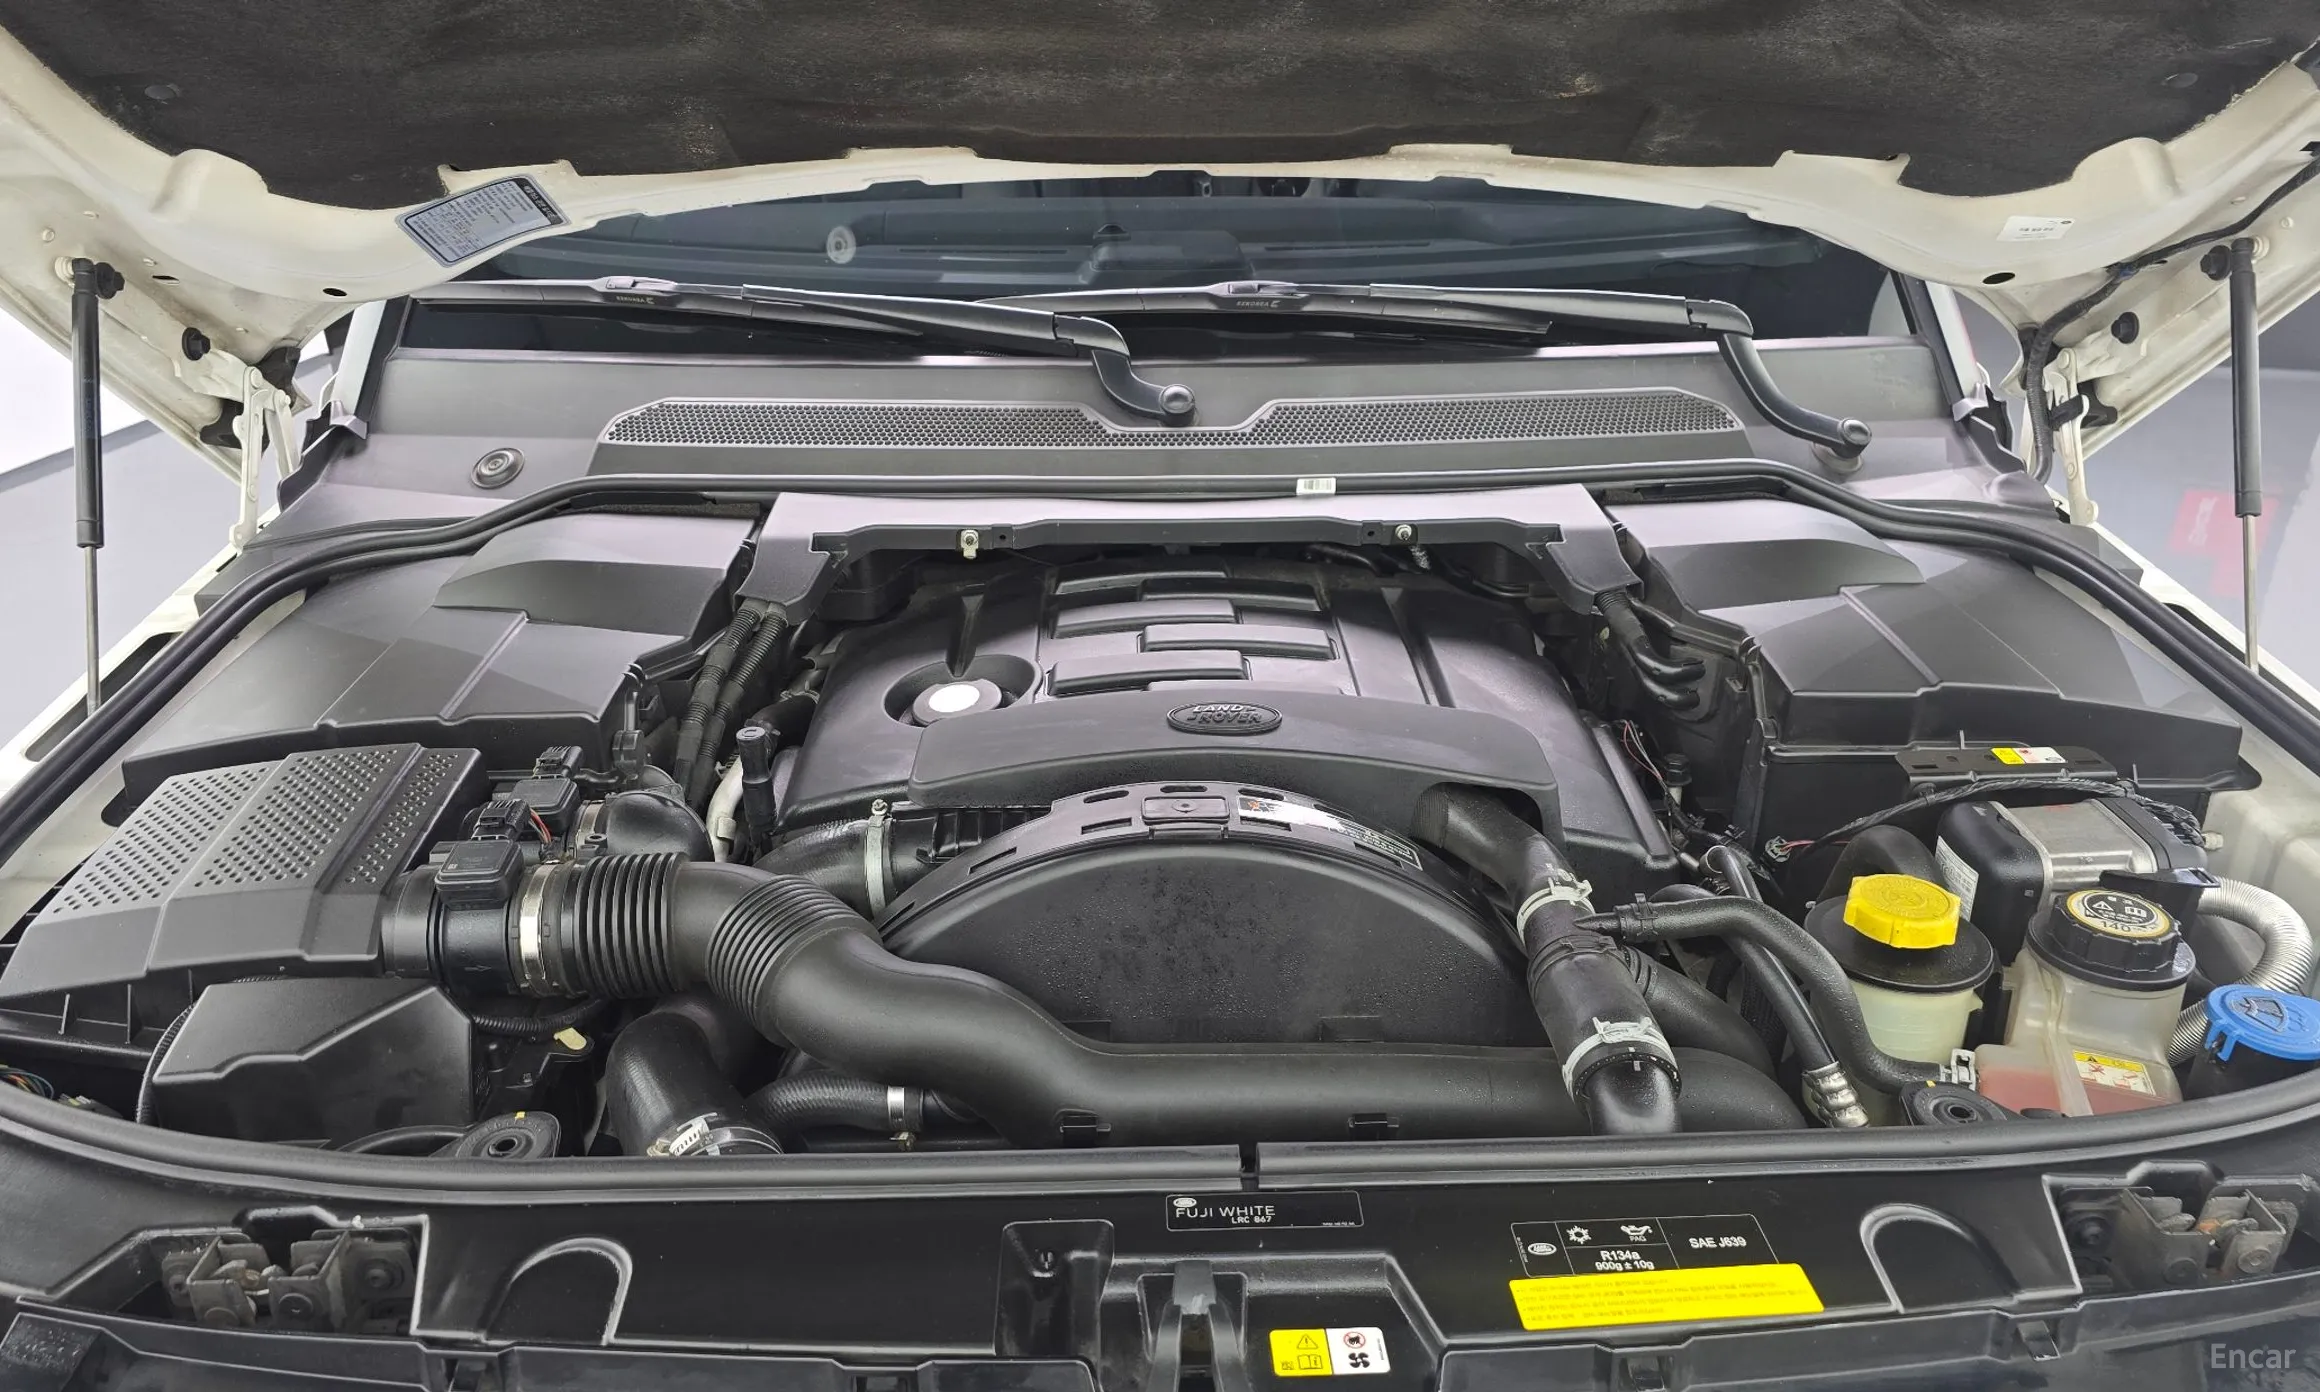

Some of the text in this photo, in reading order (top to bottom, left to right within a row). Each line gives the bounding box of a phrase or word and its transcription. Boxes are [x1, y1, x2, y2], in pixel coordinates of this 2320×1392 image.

[1193, 704, 1243, 712] LAND
[1198, 712, 1262, 723] ROVER
[2101, 921, 2131, 932] 140
[1176, 1205, 1275, 1218] FUJI WHITE
[1231, 1215, 1272, 1224] LRC 867
[1689, 1236, 1747, 1248] SAE J639
[1600, 1250, 1641, 1261] R134a
[1595, 1260, 1655, 1271] 900g ± 10g
